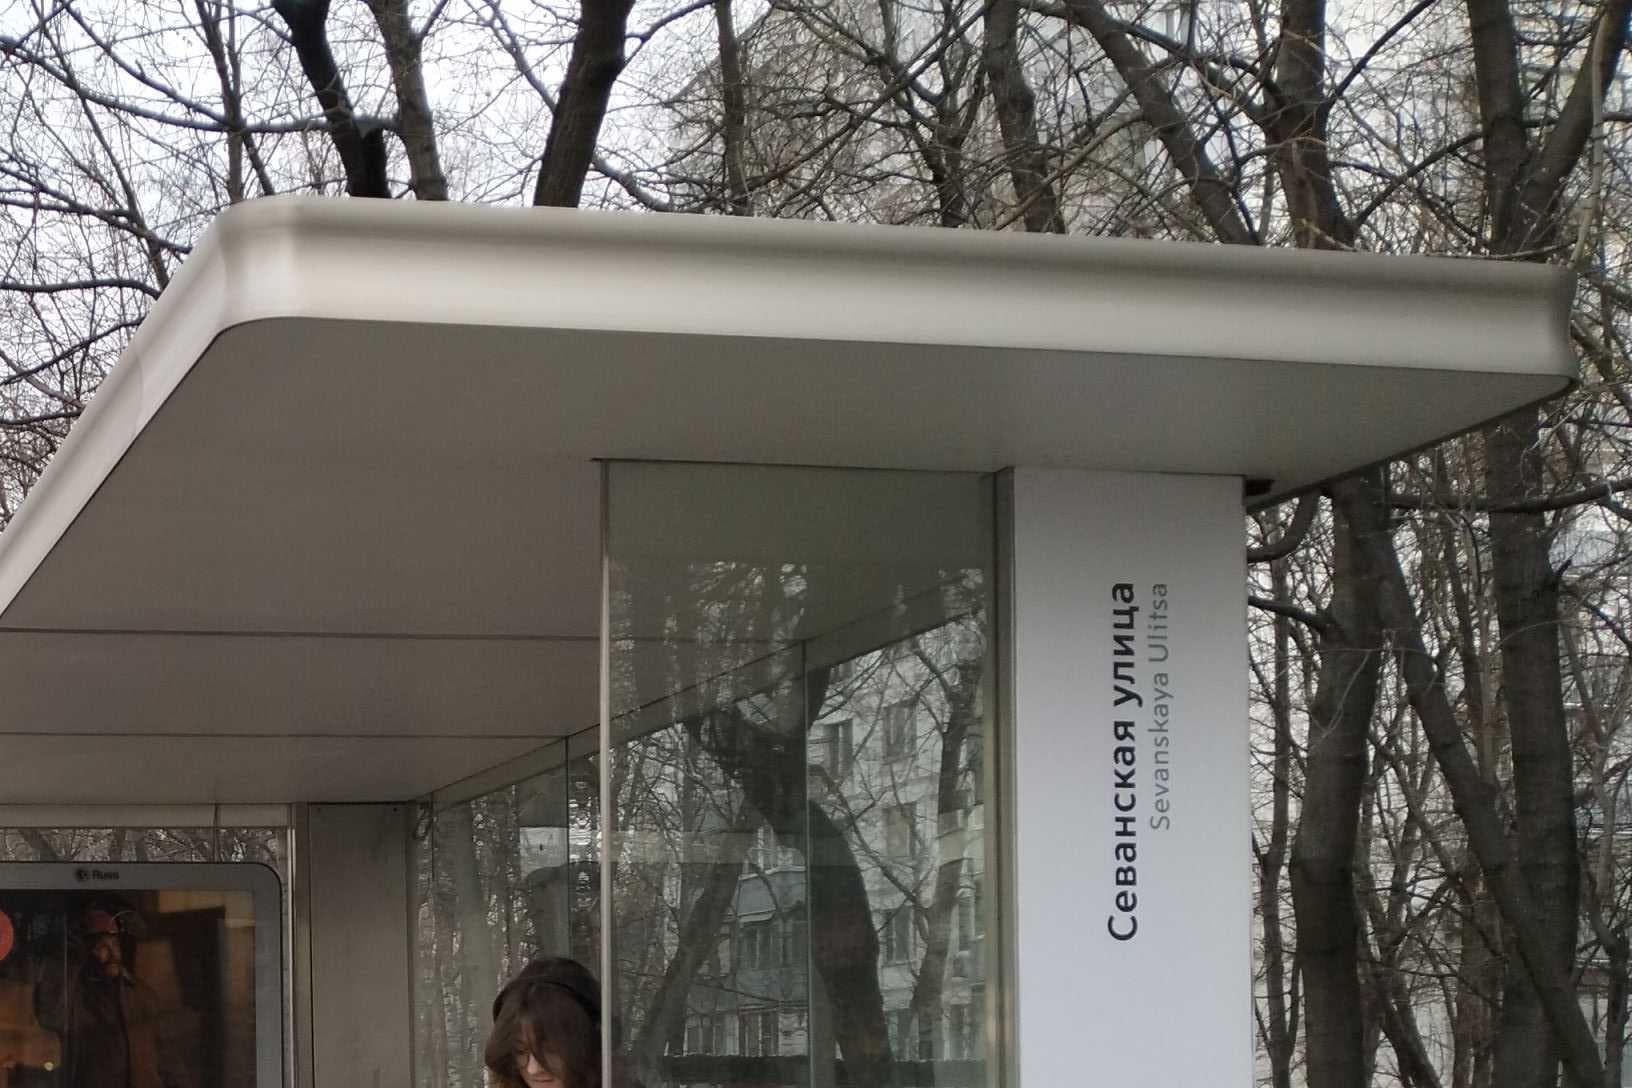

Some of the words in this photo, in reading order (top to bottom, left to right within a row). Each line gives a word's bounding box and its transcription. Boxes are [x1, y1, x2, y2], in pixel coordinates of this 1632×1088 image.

[1111, 582, 1143, 707] улица
[1147, 583, 1169, 663] Ulitsa
[1147, 672, 1175, 831] Sevanskaya
[1107, 720, 1138, 941] Севанская
